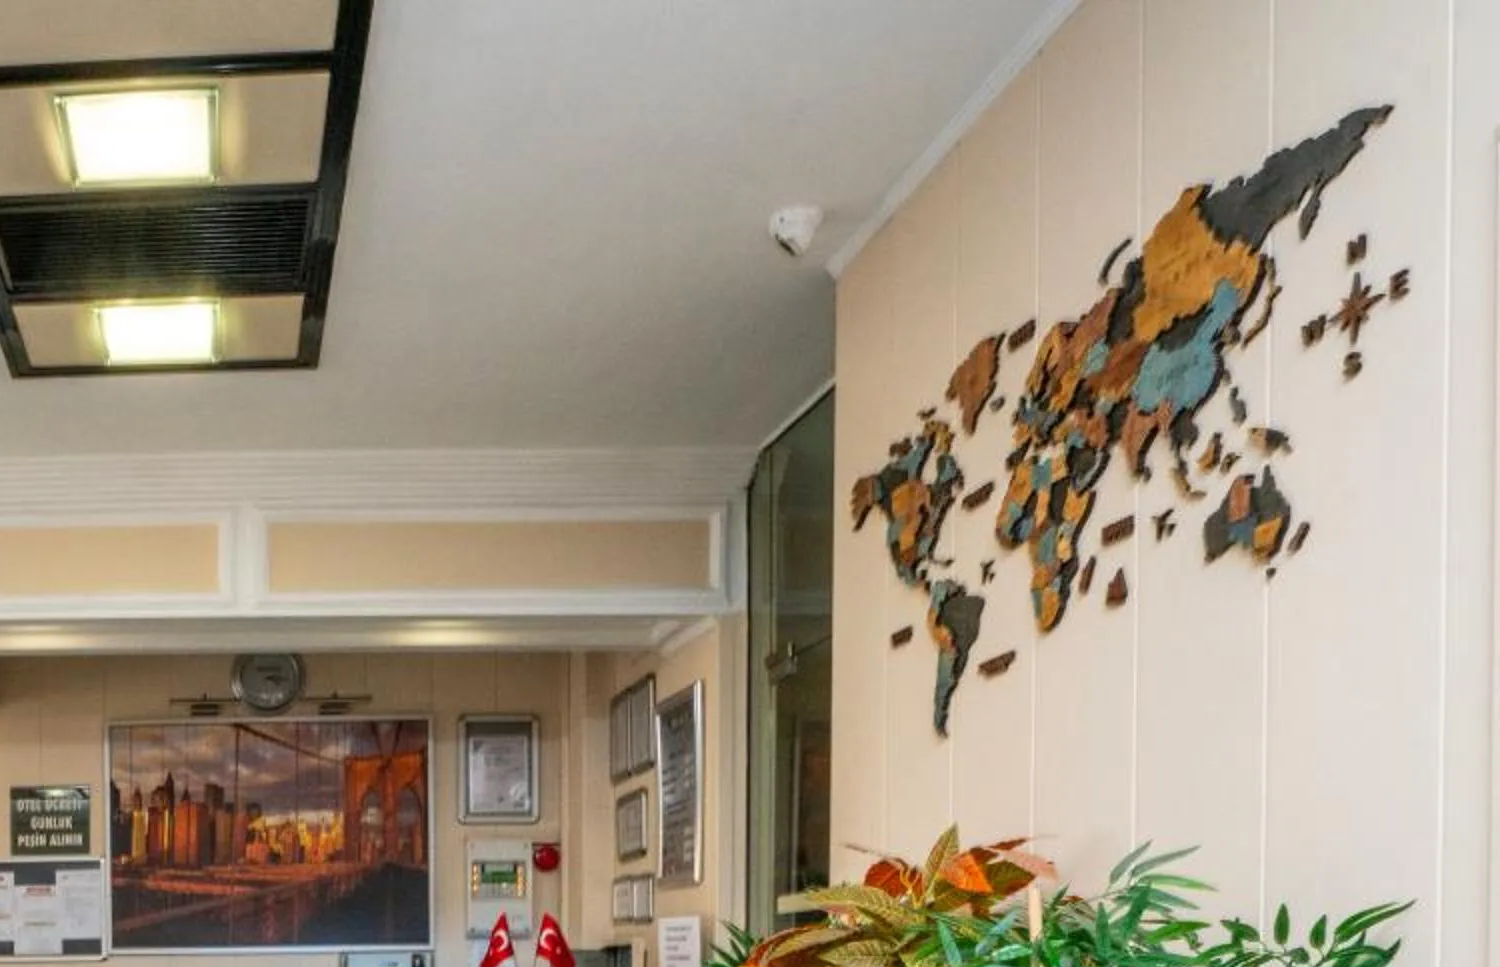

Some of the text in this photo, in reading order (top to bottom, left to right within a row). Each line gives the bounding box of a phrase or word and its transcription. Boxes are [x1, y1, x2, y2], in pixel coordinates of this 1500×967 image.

[1390, 268, 1410, 301] E
[1302, 314, 1327, 347] W
[1342, 351, 1363, 382] S
